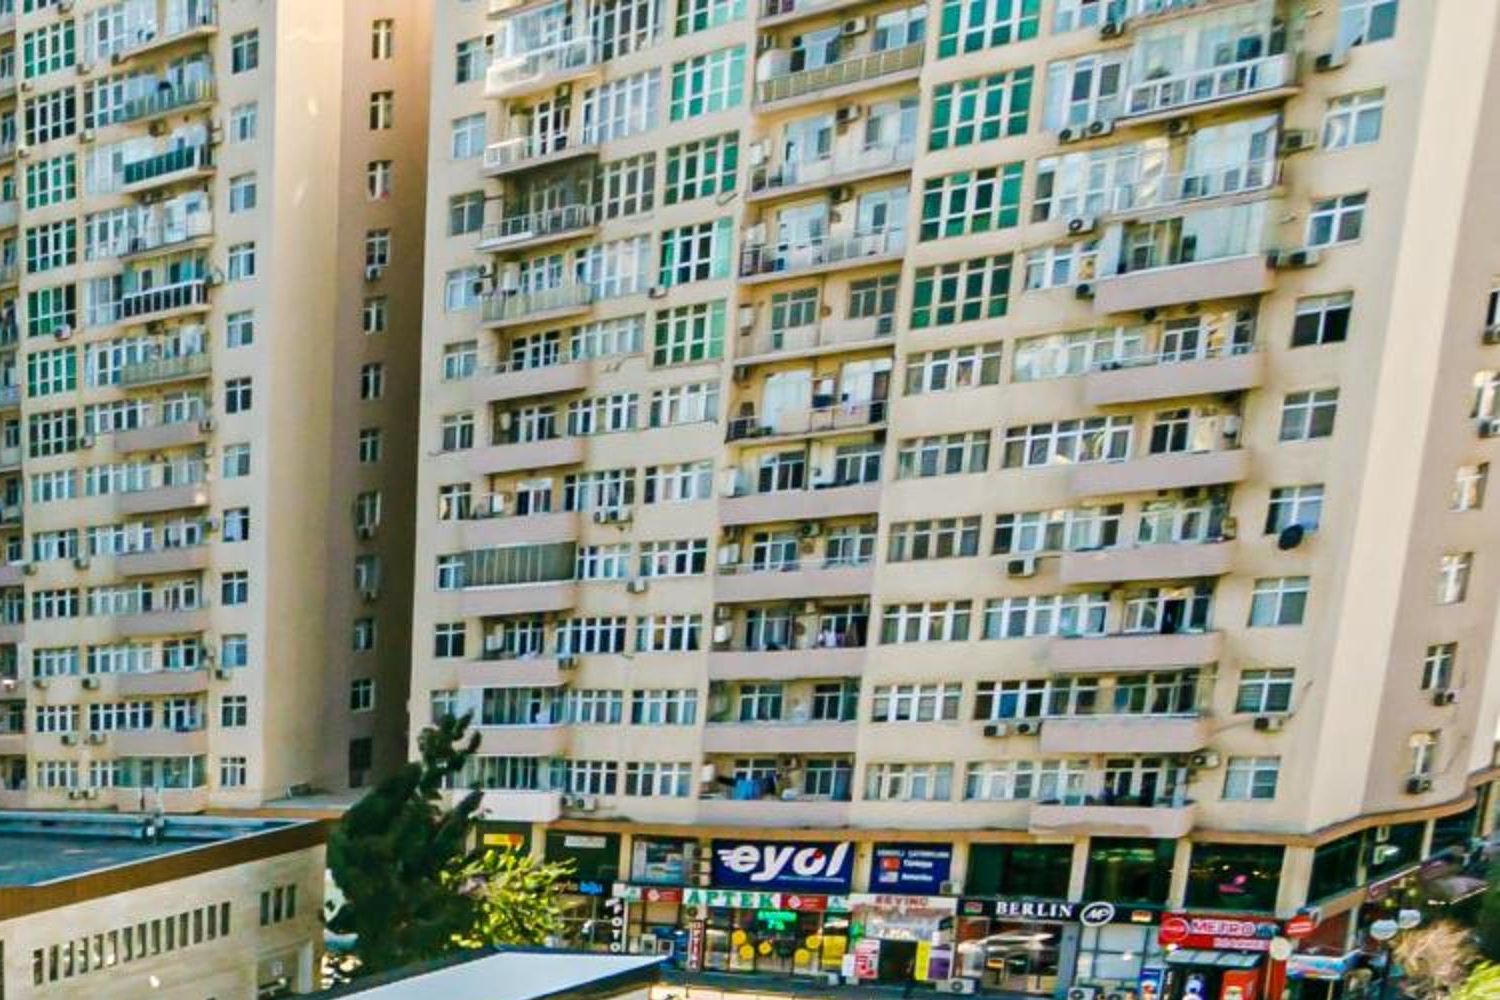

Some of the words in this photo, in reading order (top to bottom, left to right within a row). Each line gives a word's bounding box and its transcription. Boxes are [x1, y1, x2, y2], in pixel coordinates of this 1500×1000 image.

[717, 841, 851, 882] eyol
[687, 889, 773, 908] APTEK
[996, 901, 1074, 918] BERLIN
[1189, 919, 1255, 937] METRO
